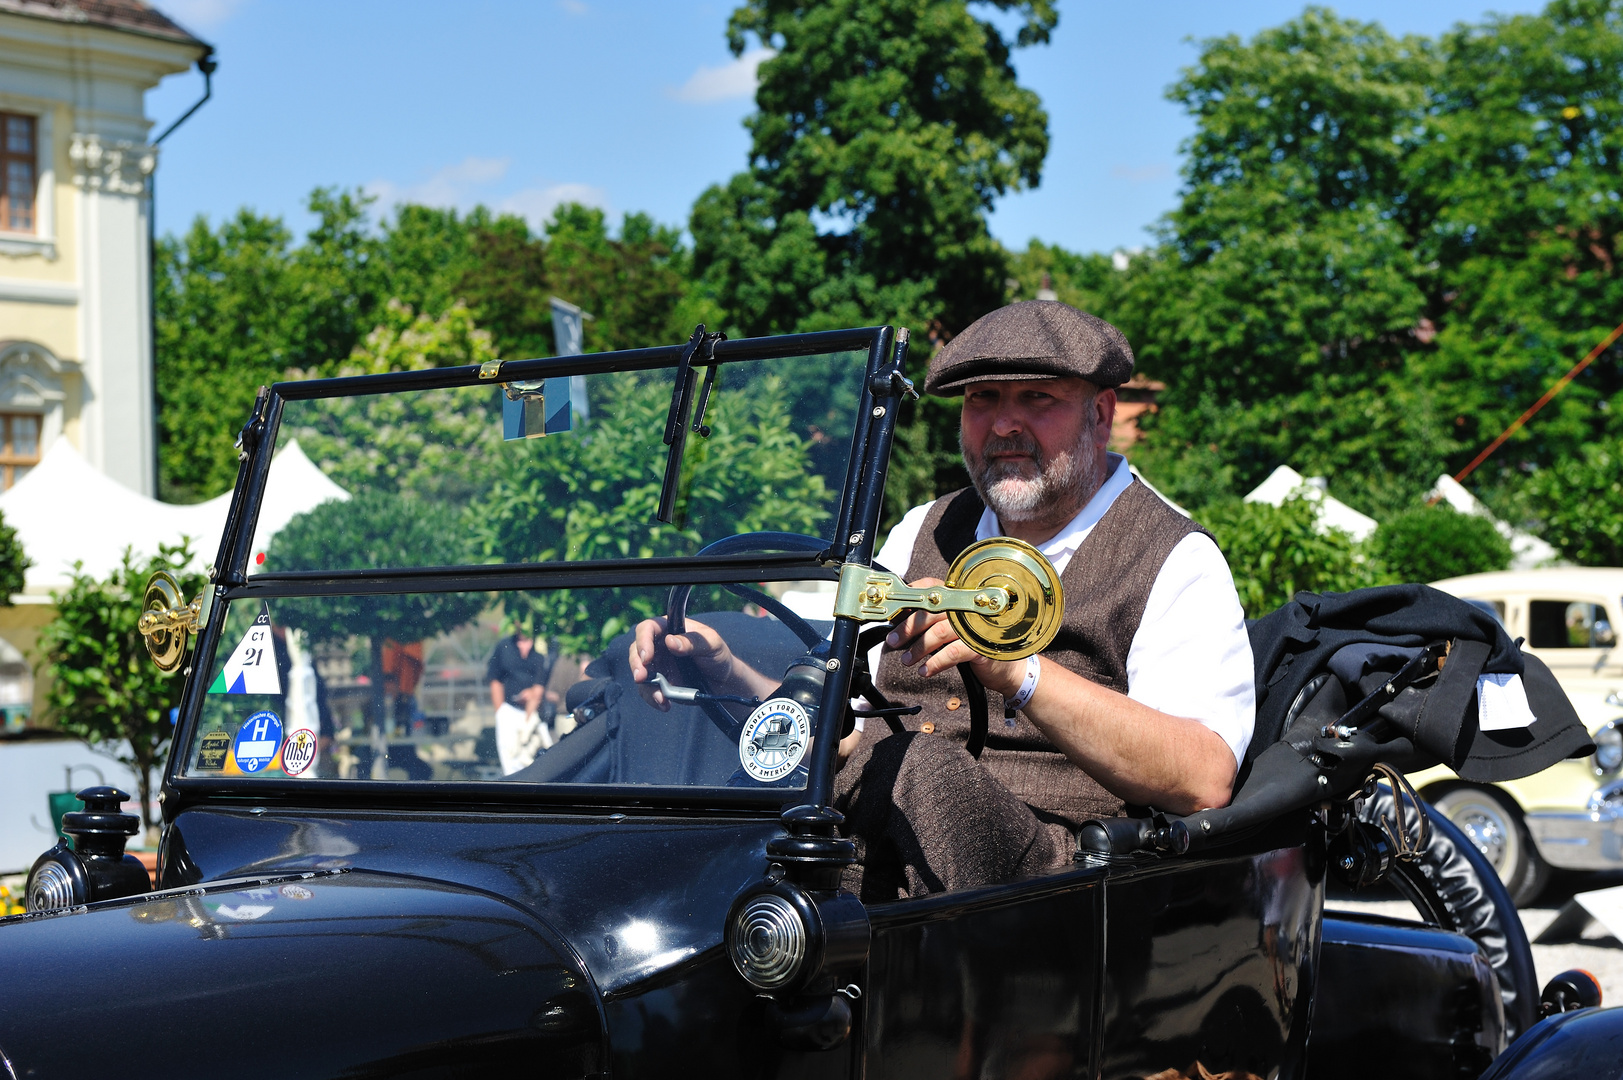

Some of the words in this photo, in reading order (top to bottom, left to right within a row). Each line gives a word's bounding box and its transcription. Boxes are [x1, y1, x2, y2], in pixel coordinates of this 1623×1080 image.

[257, 614, 269, 624] CC
[242, 647, 264, 666] 21
[746, 712, 765, 736] MODEL
[777, 704, 795, 714] FORD
[796, 714, 806, 735] CLUB
[252, 719, 269, 741] H
[749, 762, 758, 771] OF
[759, 762, 791, 777] AMERICA
